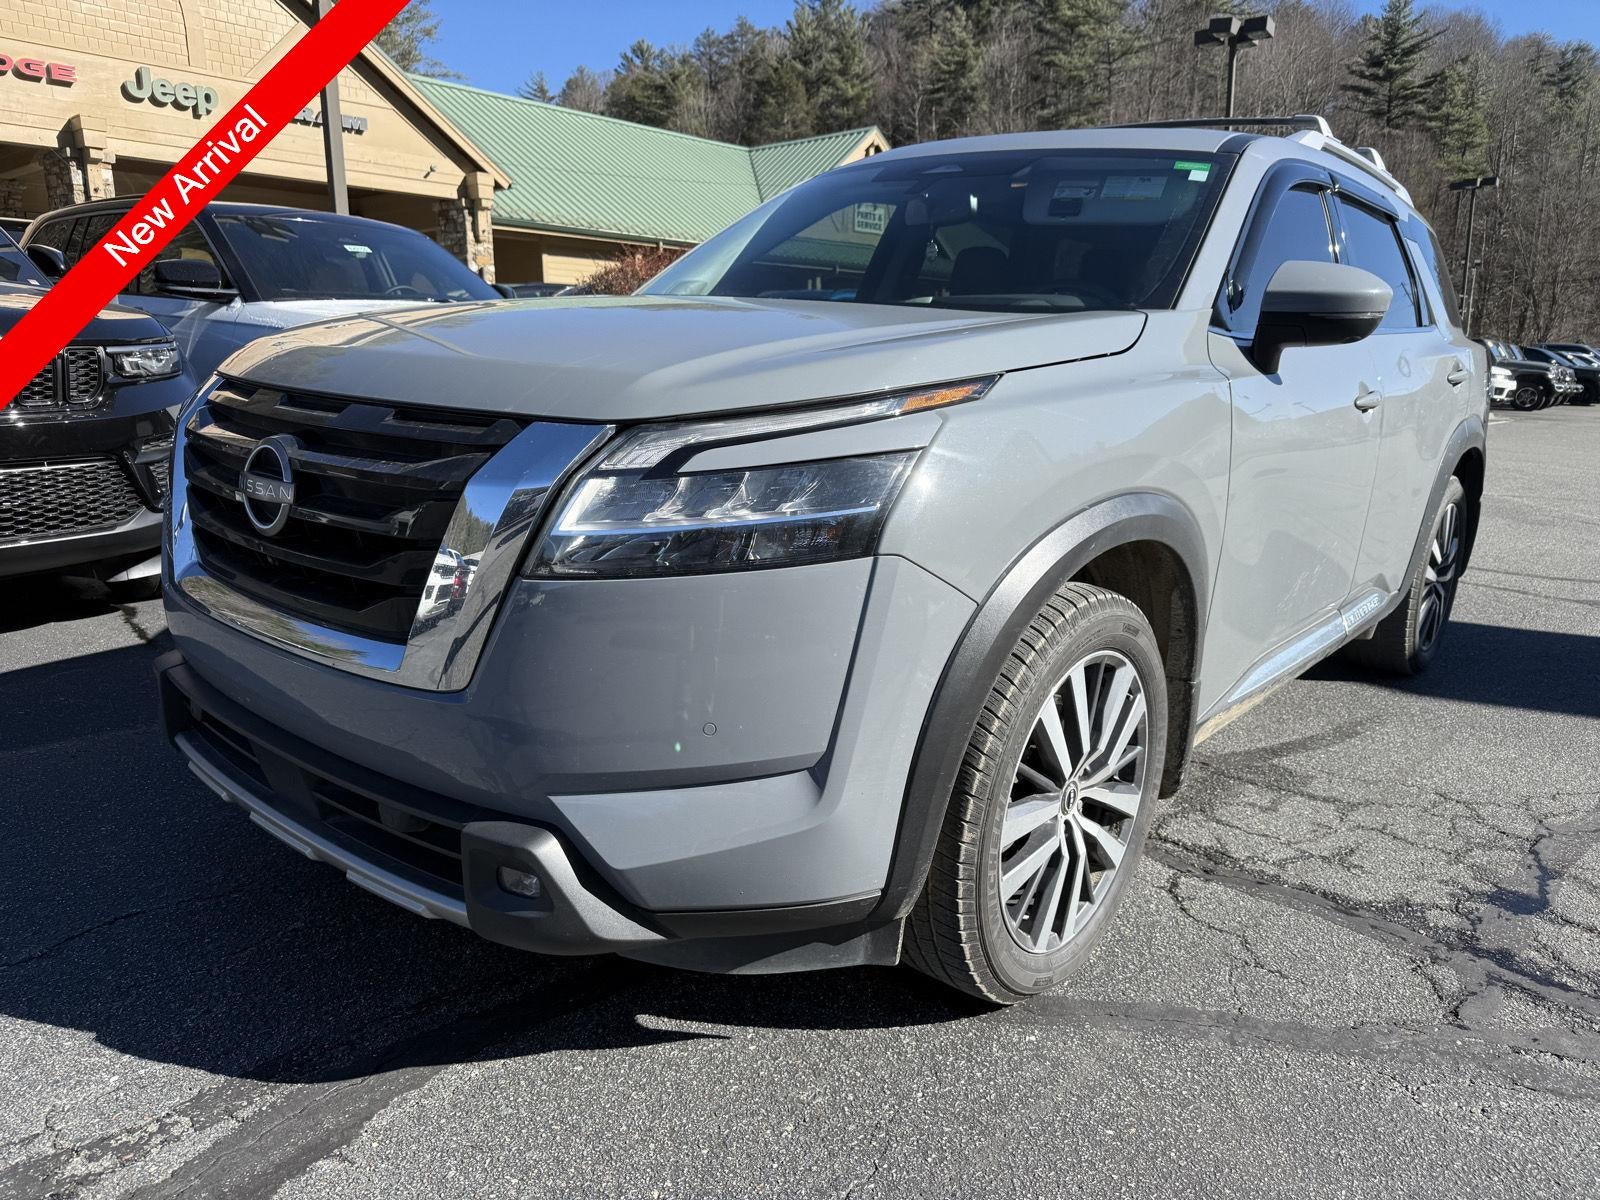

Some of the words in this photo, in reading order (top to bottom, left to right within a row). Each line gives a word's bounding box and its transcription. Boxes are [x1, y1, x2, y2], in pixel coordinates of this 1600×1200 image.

[120, 66, 219, 119] Jeep
[292, 107, 369, 135] RM
[857, 211, 876, 221] PARTS
[857, 220, 882, 231] SERVICE
[238, 473, 292, 500] NISSAN
